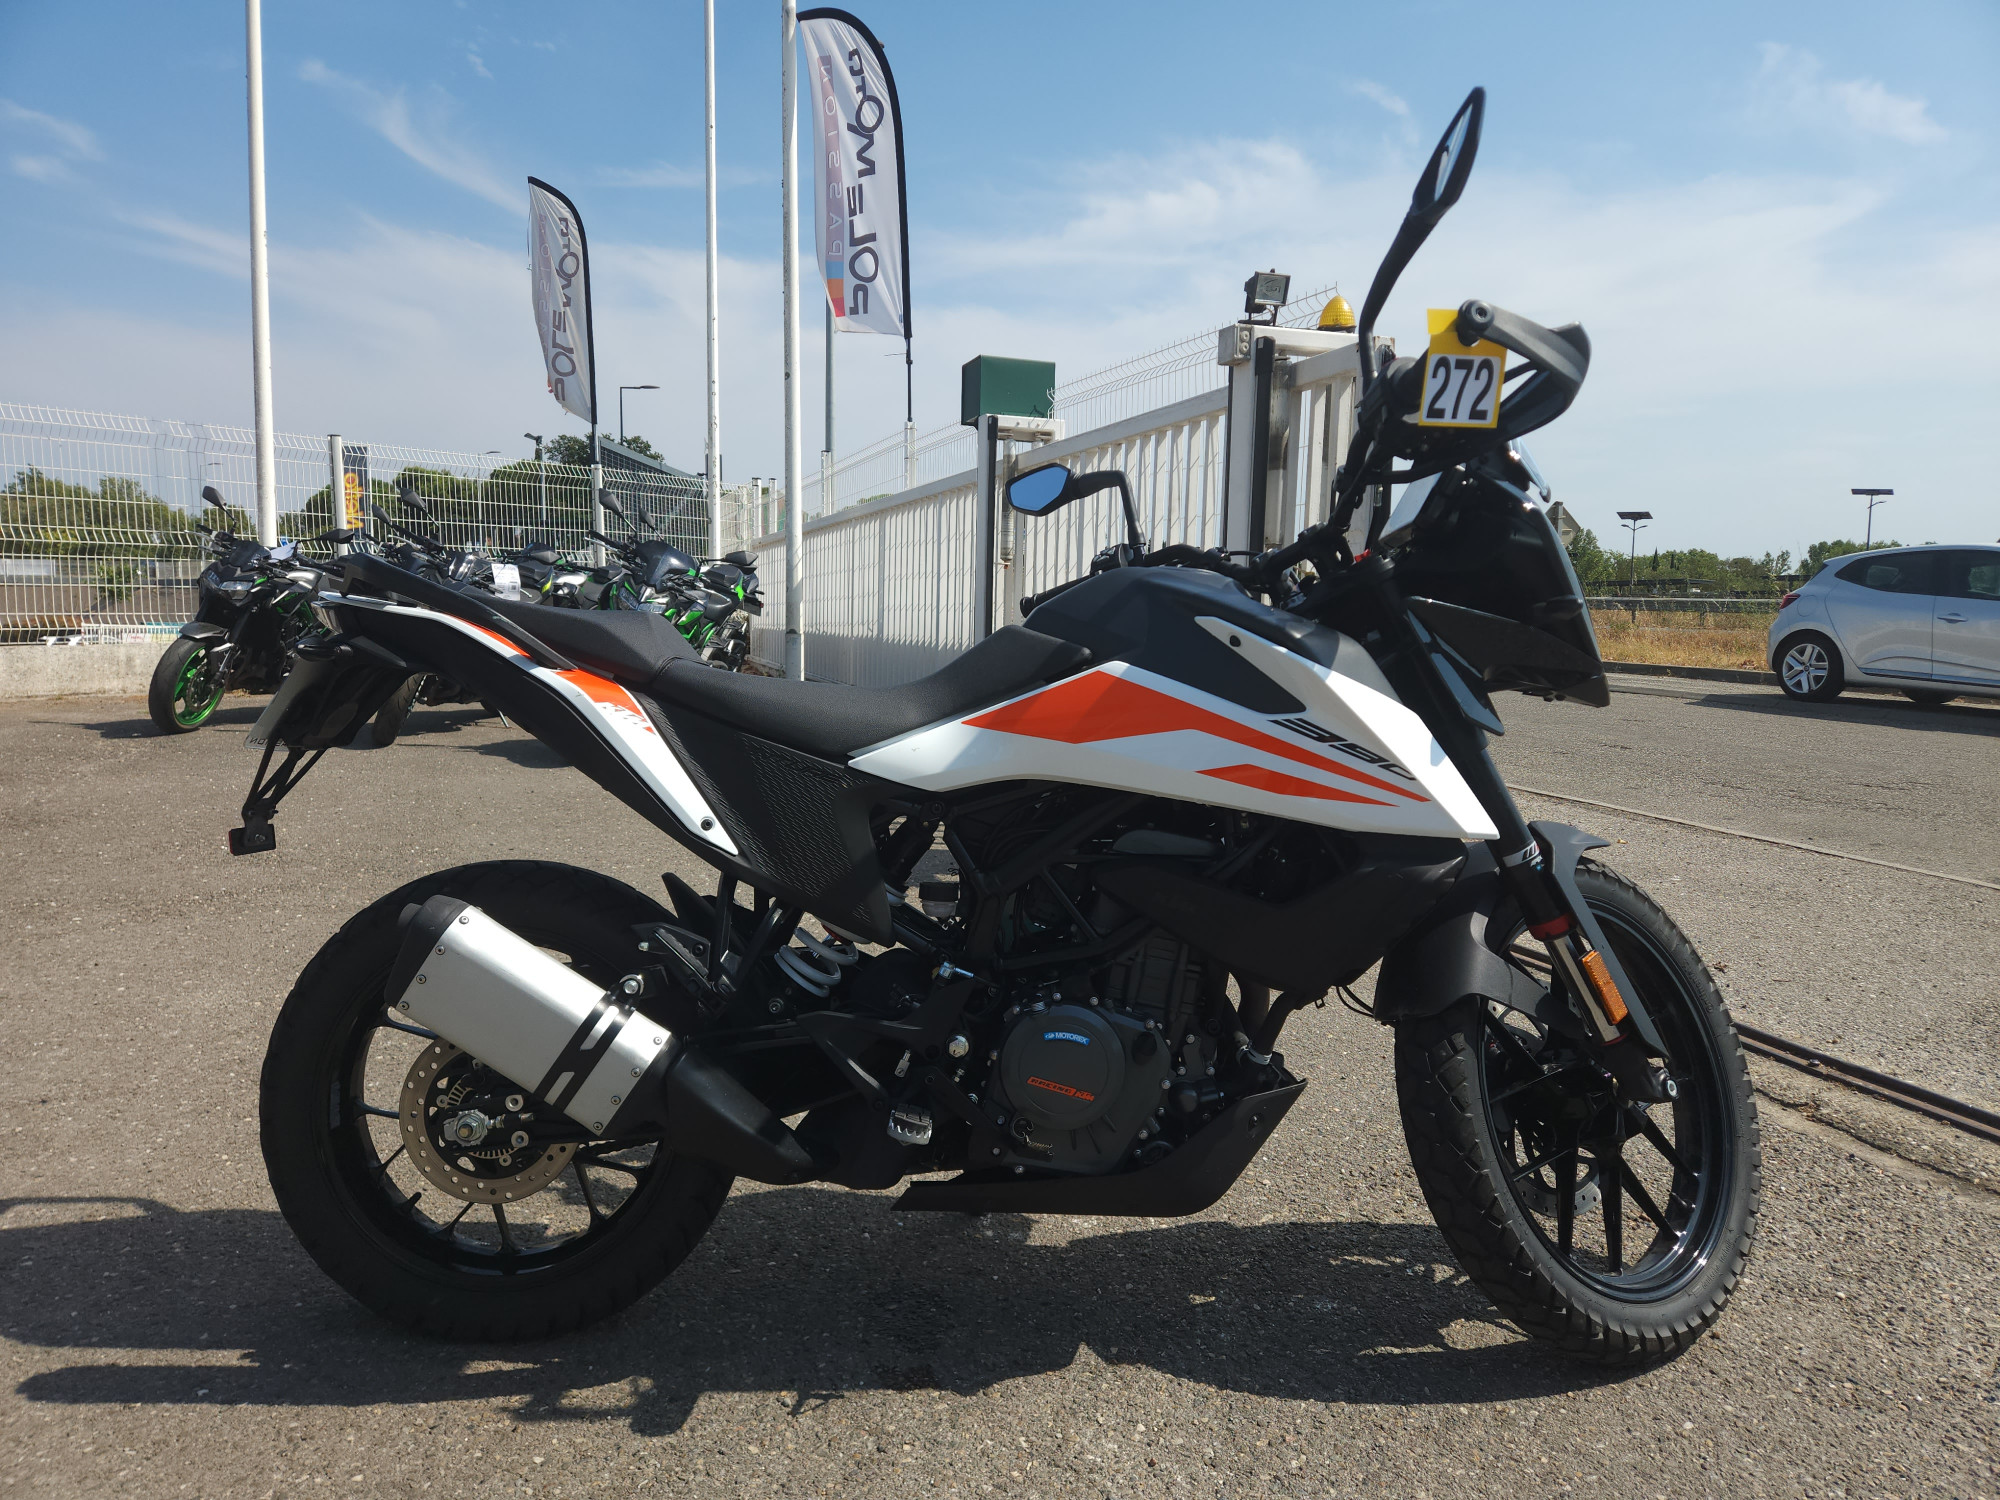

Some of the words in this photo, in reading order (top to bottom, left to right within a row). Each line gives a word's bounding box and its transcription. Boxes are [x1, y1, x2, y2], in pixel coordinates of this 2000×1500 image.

[1426, 355, 1494, 420] 272
[1055, 1031, 1087, 1045] MOTOREX
[1029, 1077, 1074, 1096] RACING
